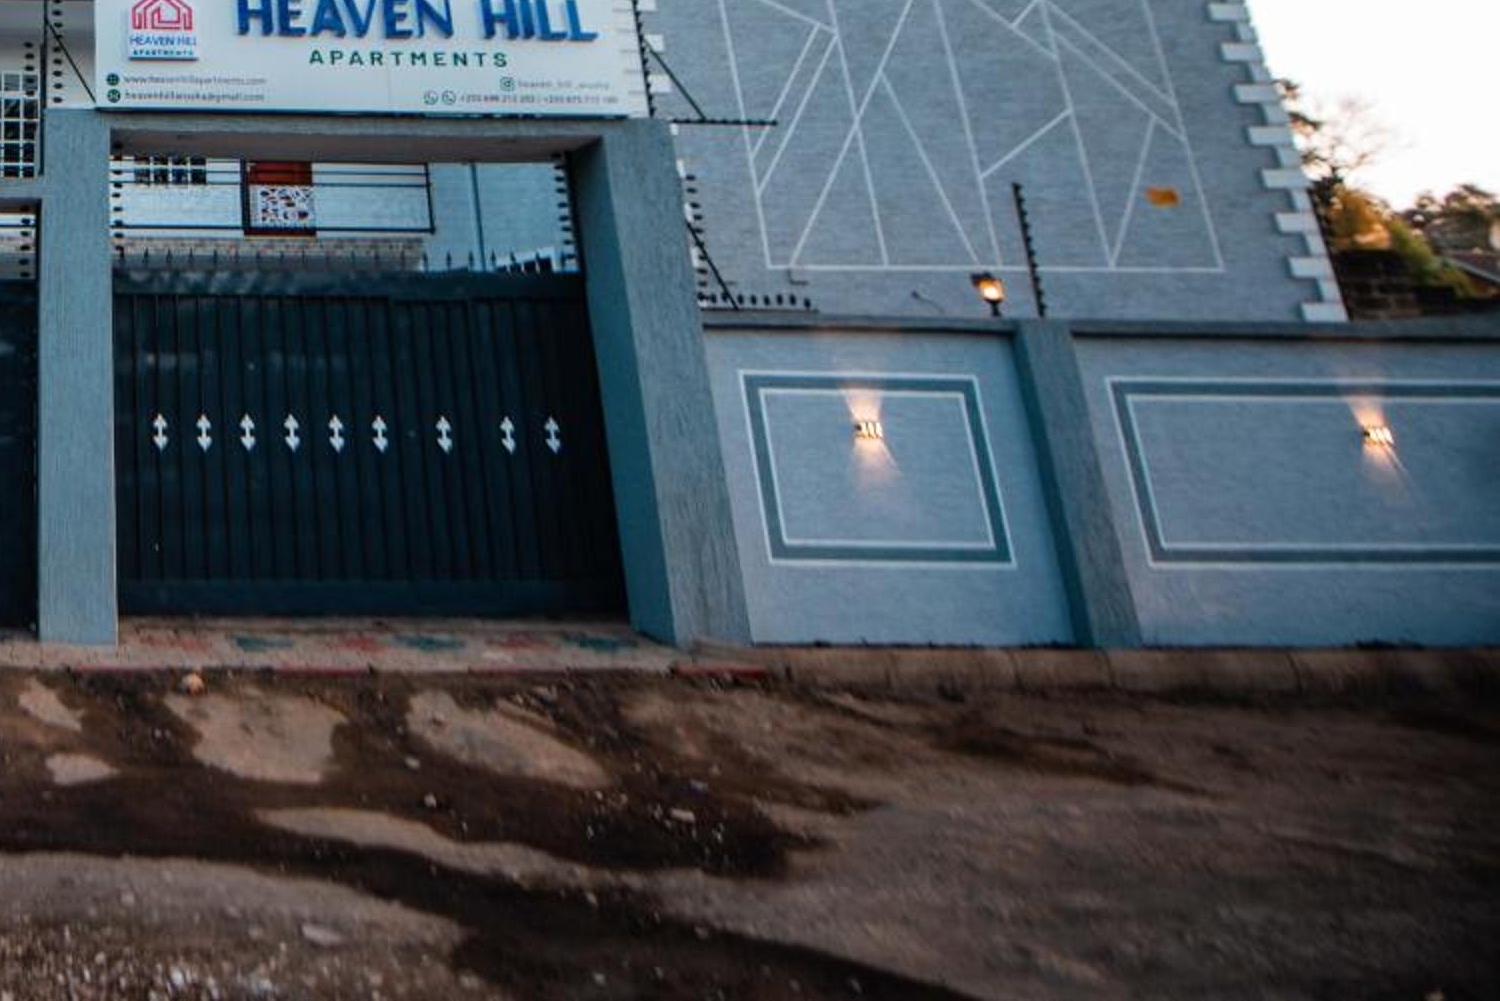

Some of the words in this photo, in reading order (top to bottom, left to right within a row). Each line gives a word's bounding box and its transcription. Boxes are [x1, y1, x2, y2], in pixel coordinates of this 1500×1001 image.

[129, 34, 175, 46] HEAVEN
[177, 34, 197, 46] HILL
[132, 48, 194, 56] APARTMENTS
[308, 49, 509, 68] APARTMENTS
